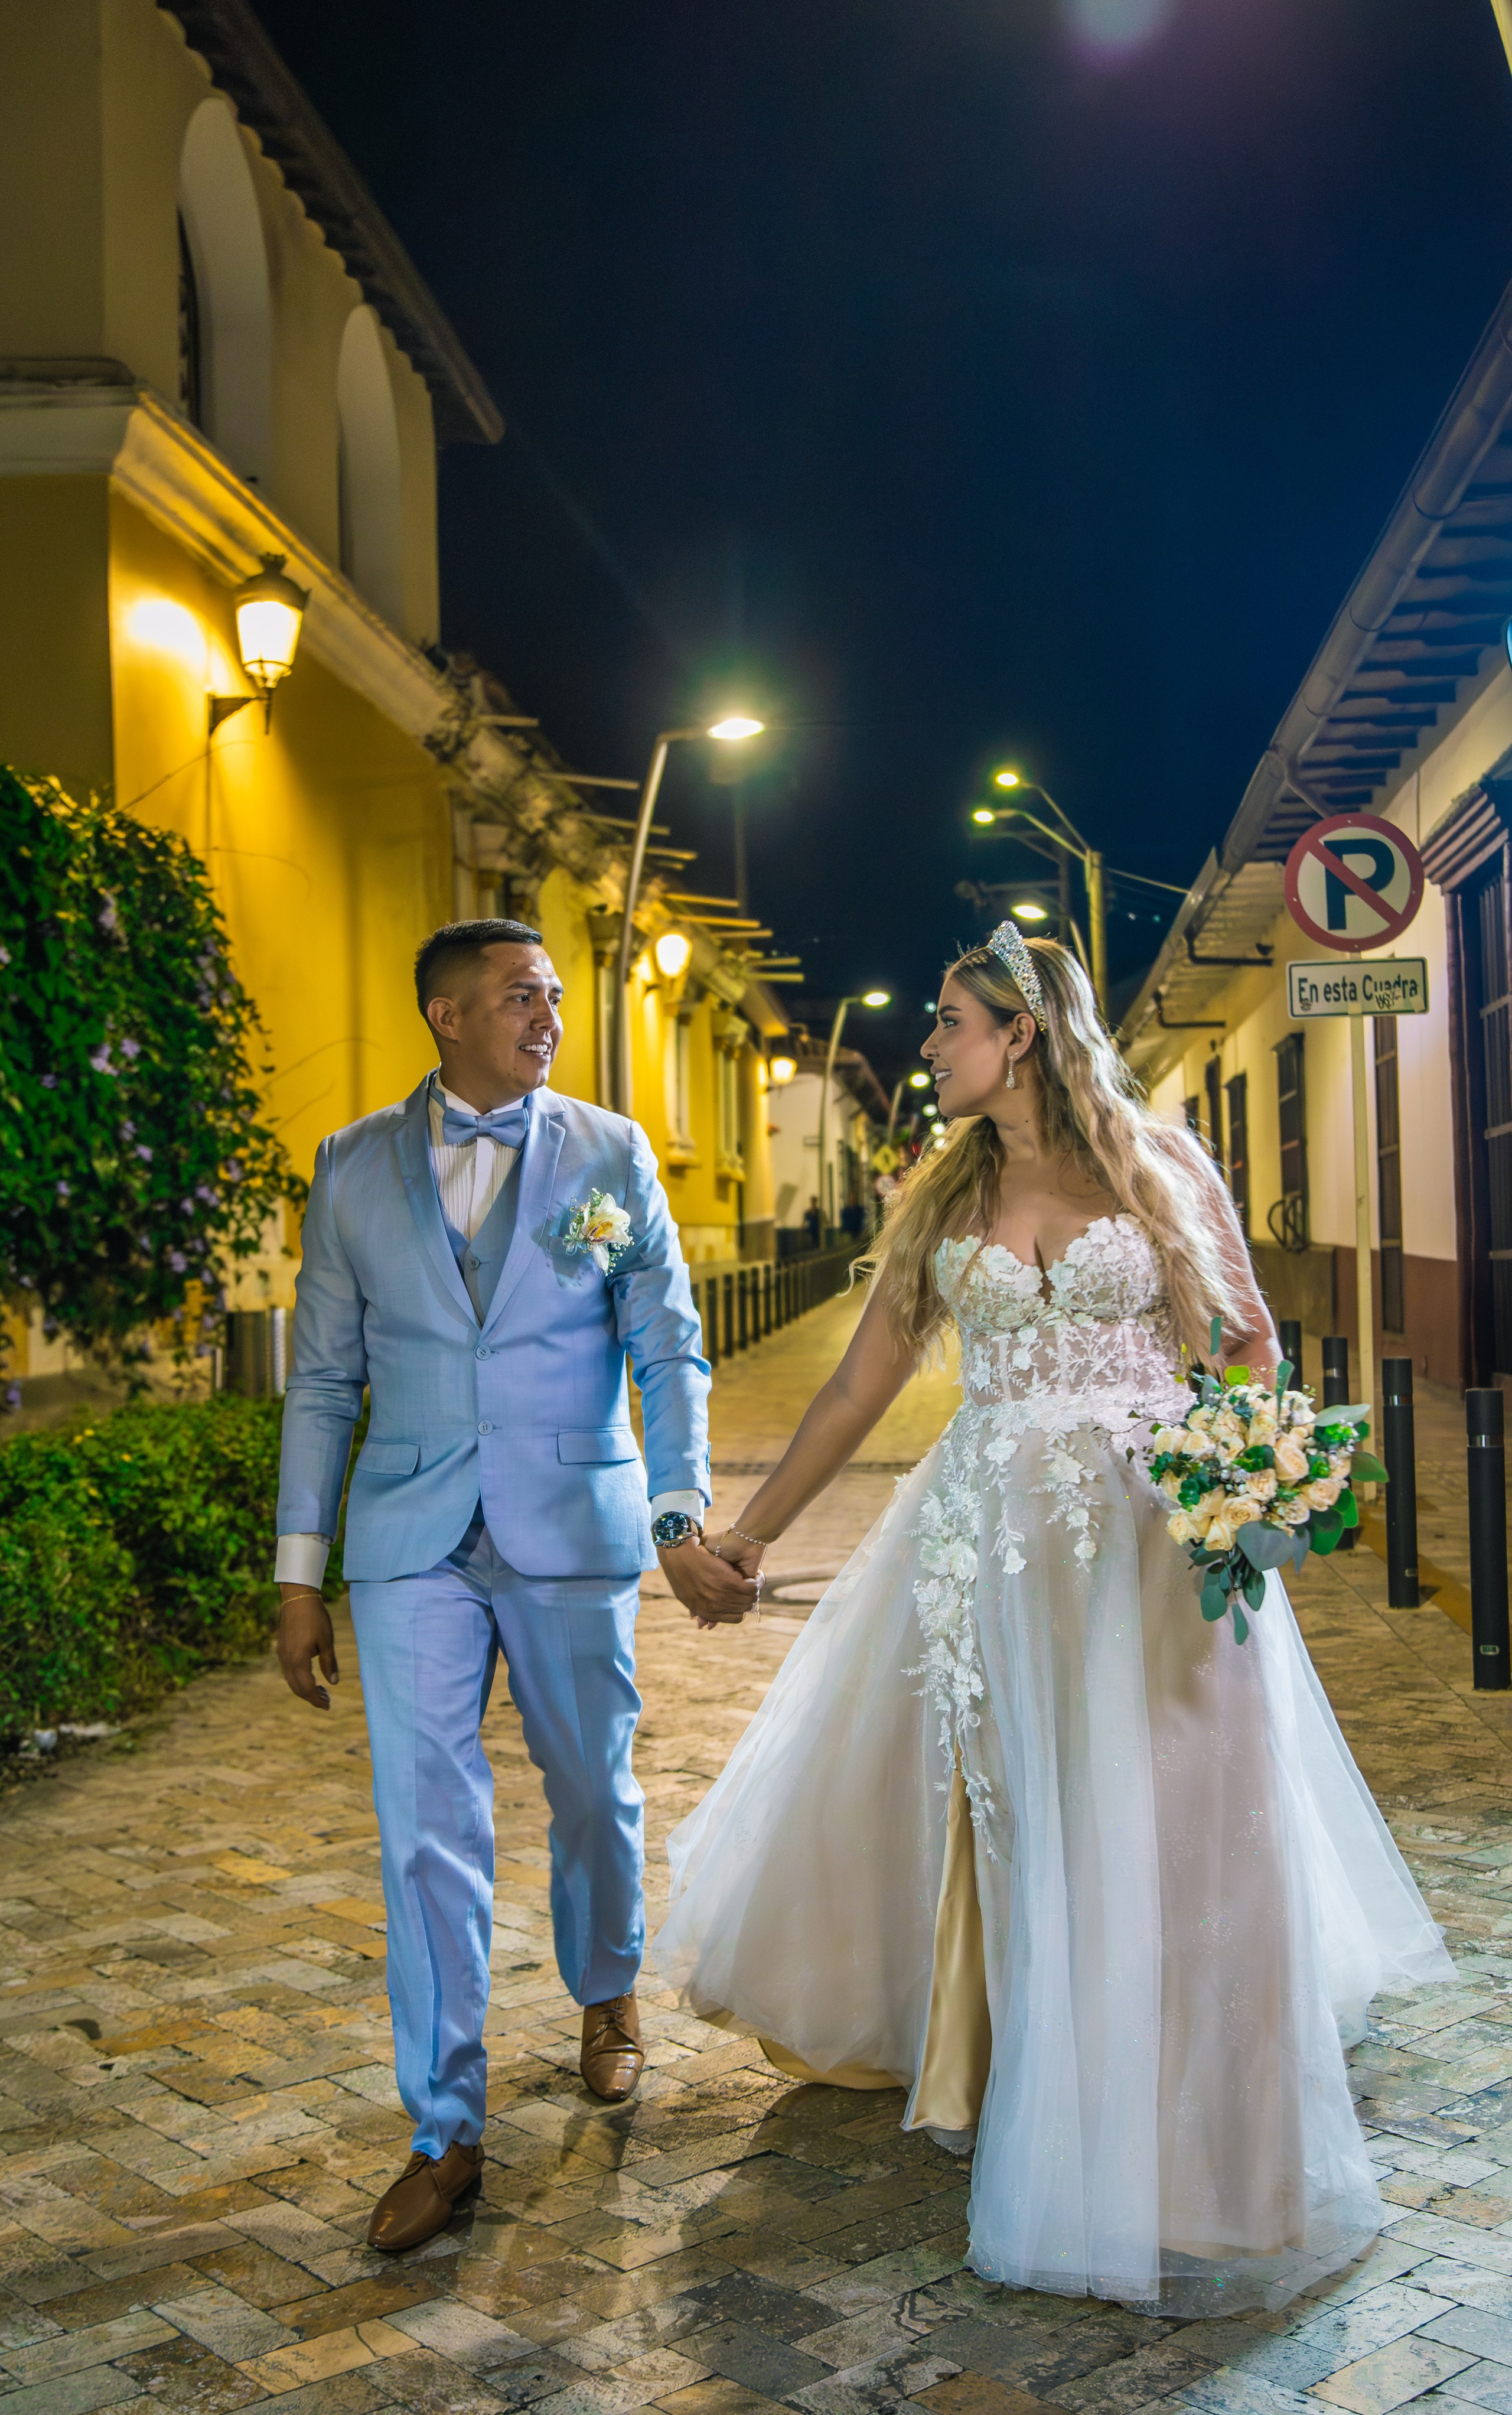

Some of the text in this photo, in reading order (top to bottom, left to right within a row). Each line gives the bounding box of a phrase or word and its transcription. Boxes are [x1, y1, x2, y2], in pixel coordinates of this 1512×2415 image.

[1324, 838, 1395, 930] P
[1298, 977, 1318, 1003] En
[1323, 975, 1357, 1003] esta
